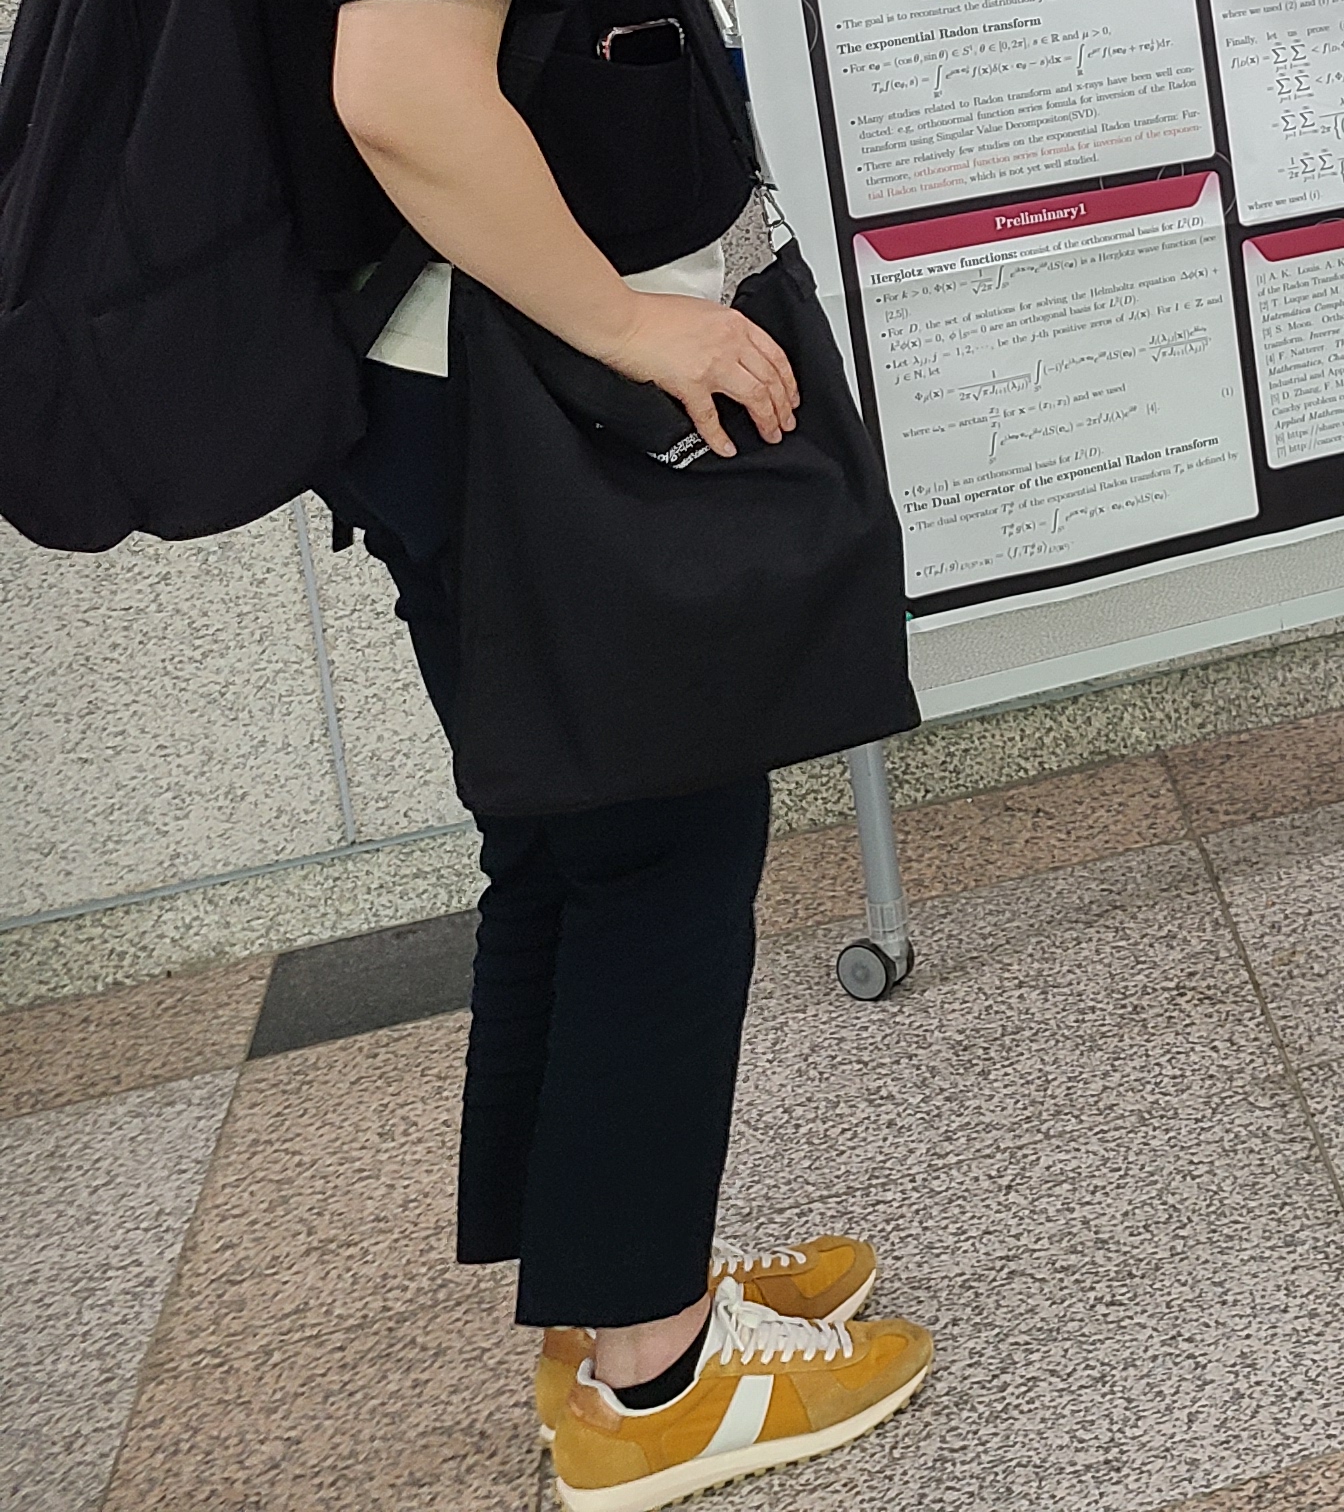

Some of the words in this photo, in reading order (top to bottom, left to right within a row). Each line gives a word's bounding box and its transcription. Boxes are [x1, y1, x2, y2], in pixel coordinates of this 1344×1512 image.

[836, 42, 862, 56] The
[864, 29, 936, 52] exponential
[938, 25, 979, 40] Radon
[982, 17, 1042, 33] transform
[860, 140, 907, 155] transform
[908, 134, 935, 147] using
[935, 127, 974, 142] Singular
[975, 123, 1004, 135] Value
[994, 202, 1086, 230] Preliminary1
[869, 267, 924, 286] Herglotz
[926, 262, 957, 274] wave
[959, 250, 1018, 269] functions:
[902, 501, 928, 514] The
[930, 492, 961, 509] Dual
[963, 484, 1016, 503] operator
[1018, 477, 1032, 490] of
[1033, 475, 1054, 487] the
[1056, 456, 1122, 482] exponential
[1124, 450, 1162, 466] Radon
[1164, 436, 1219, 456] transform
